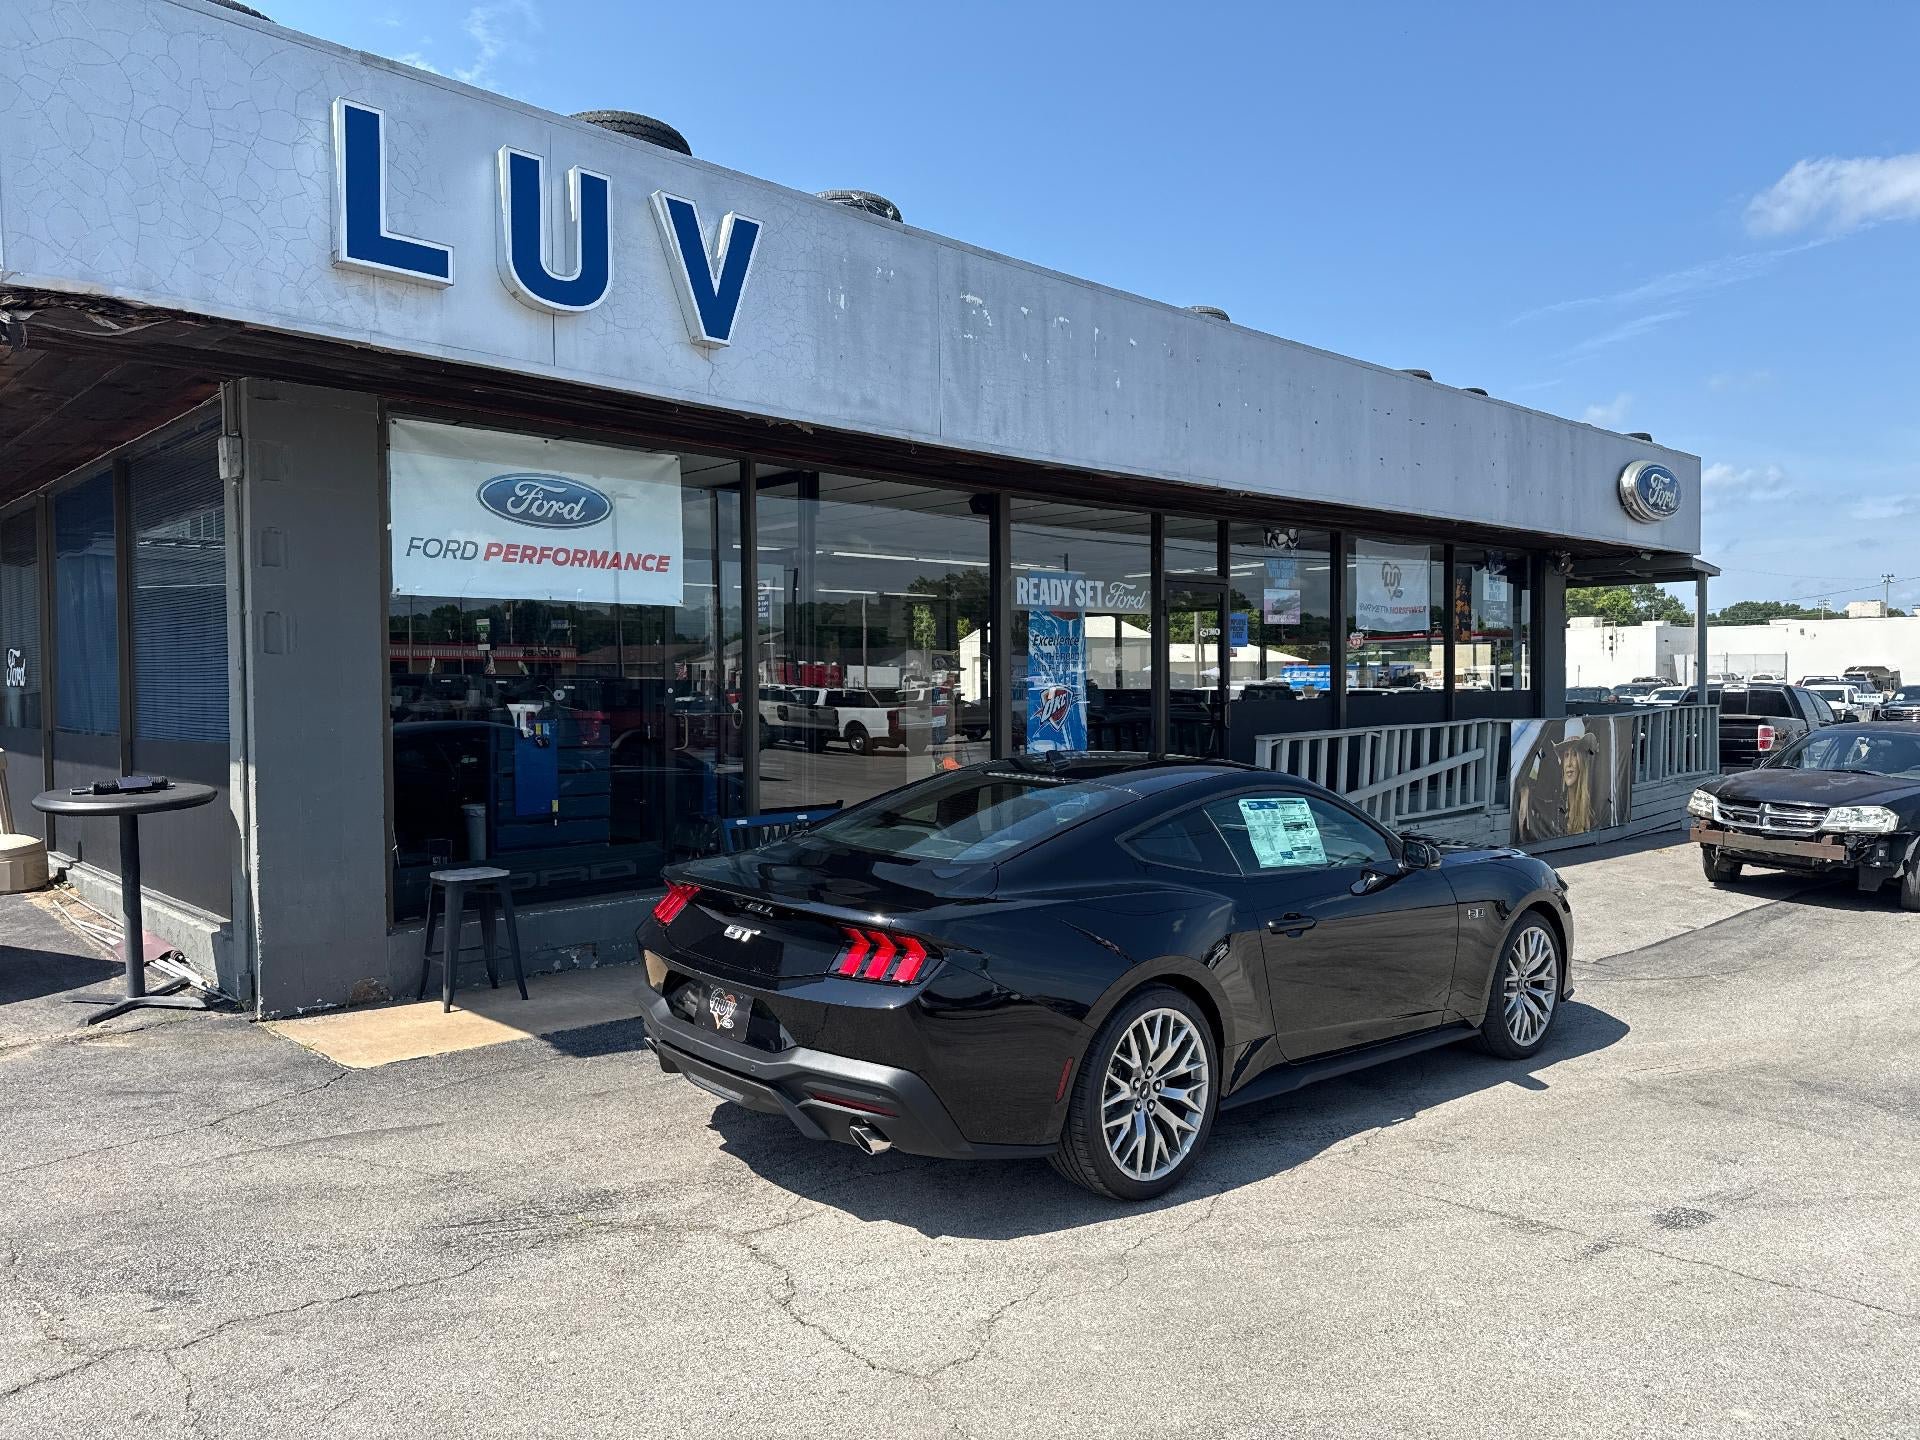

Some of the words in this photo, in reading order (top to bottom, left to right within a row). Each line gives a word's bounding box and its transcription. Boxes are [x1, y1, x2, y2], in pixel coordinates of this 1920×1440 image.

[331, 96, 765, 348] LUV
[506, 481, 585, 521] Ford
[1649, 474, 1676, 508] Ford
[405, 536, 478, 561] FORD
[484, 542, 671, 573] PERFORMANCE
[1016, 576, 1072, 607] READY
[1074, 578, 1105, 608] SET
[1105, 581, 1146, 609] Ford
[1032, 633, 1080, 647] Excellence
[6, 648, 26, 687] Ford
[724, 924, 761, 942] GT
[712, 997, 737, 1016] LUV
